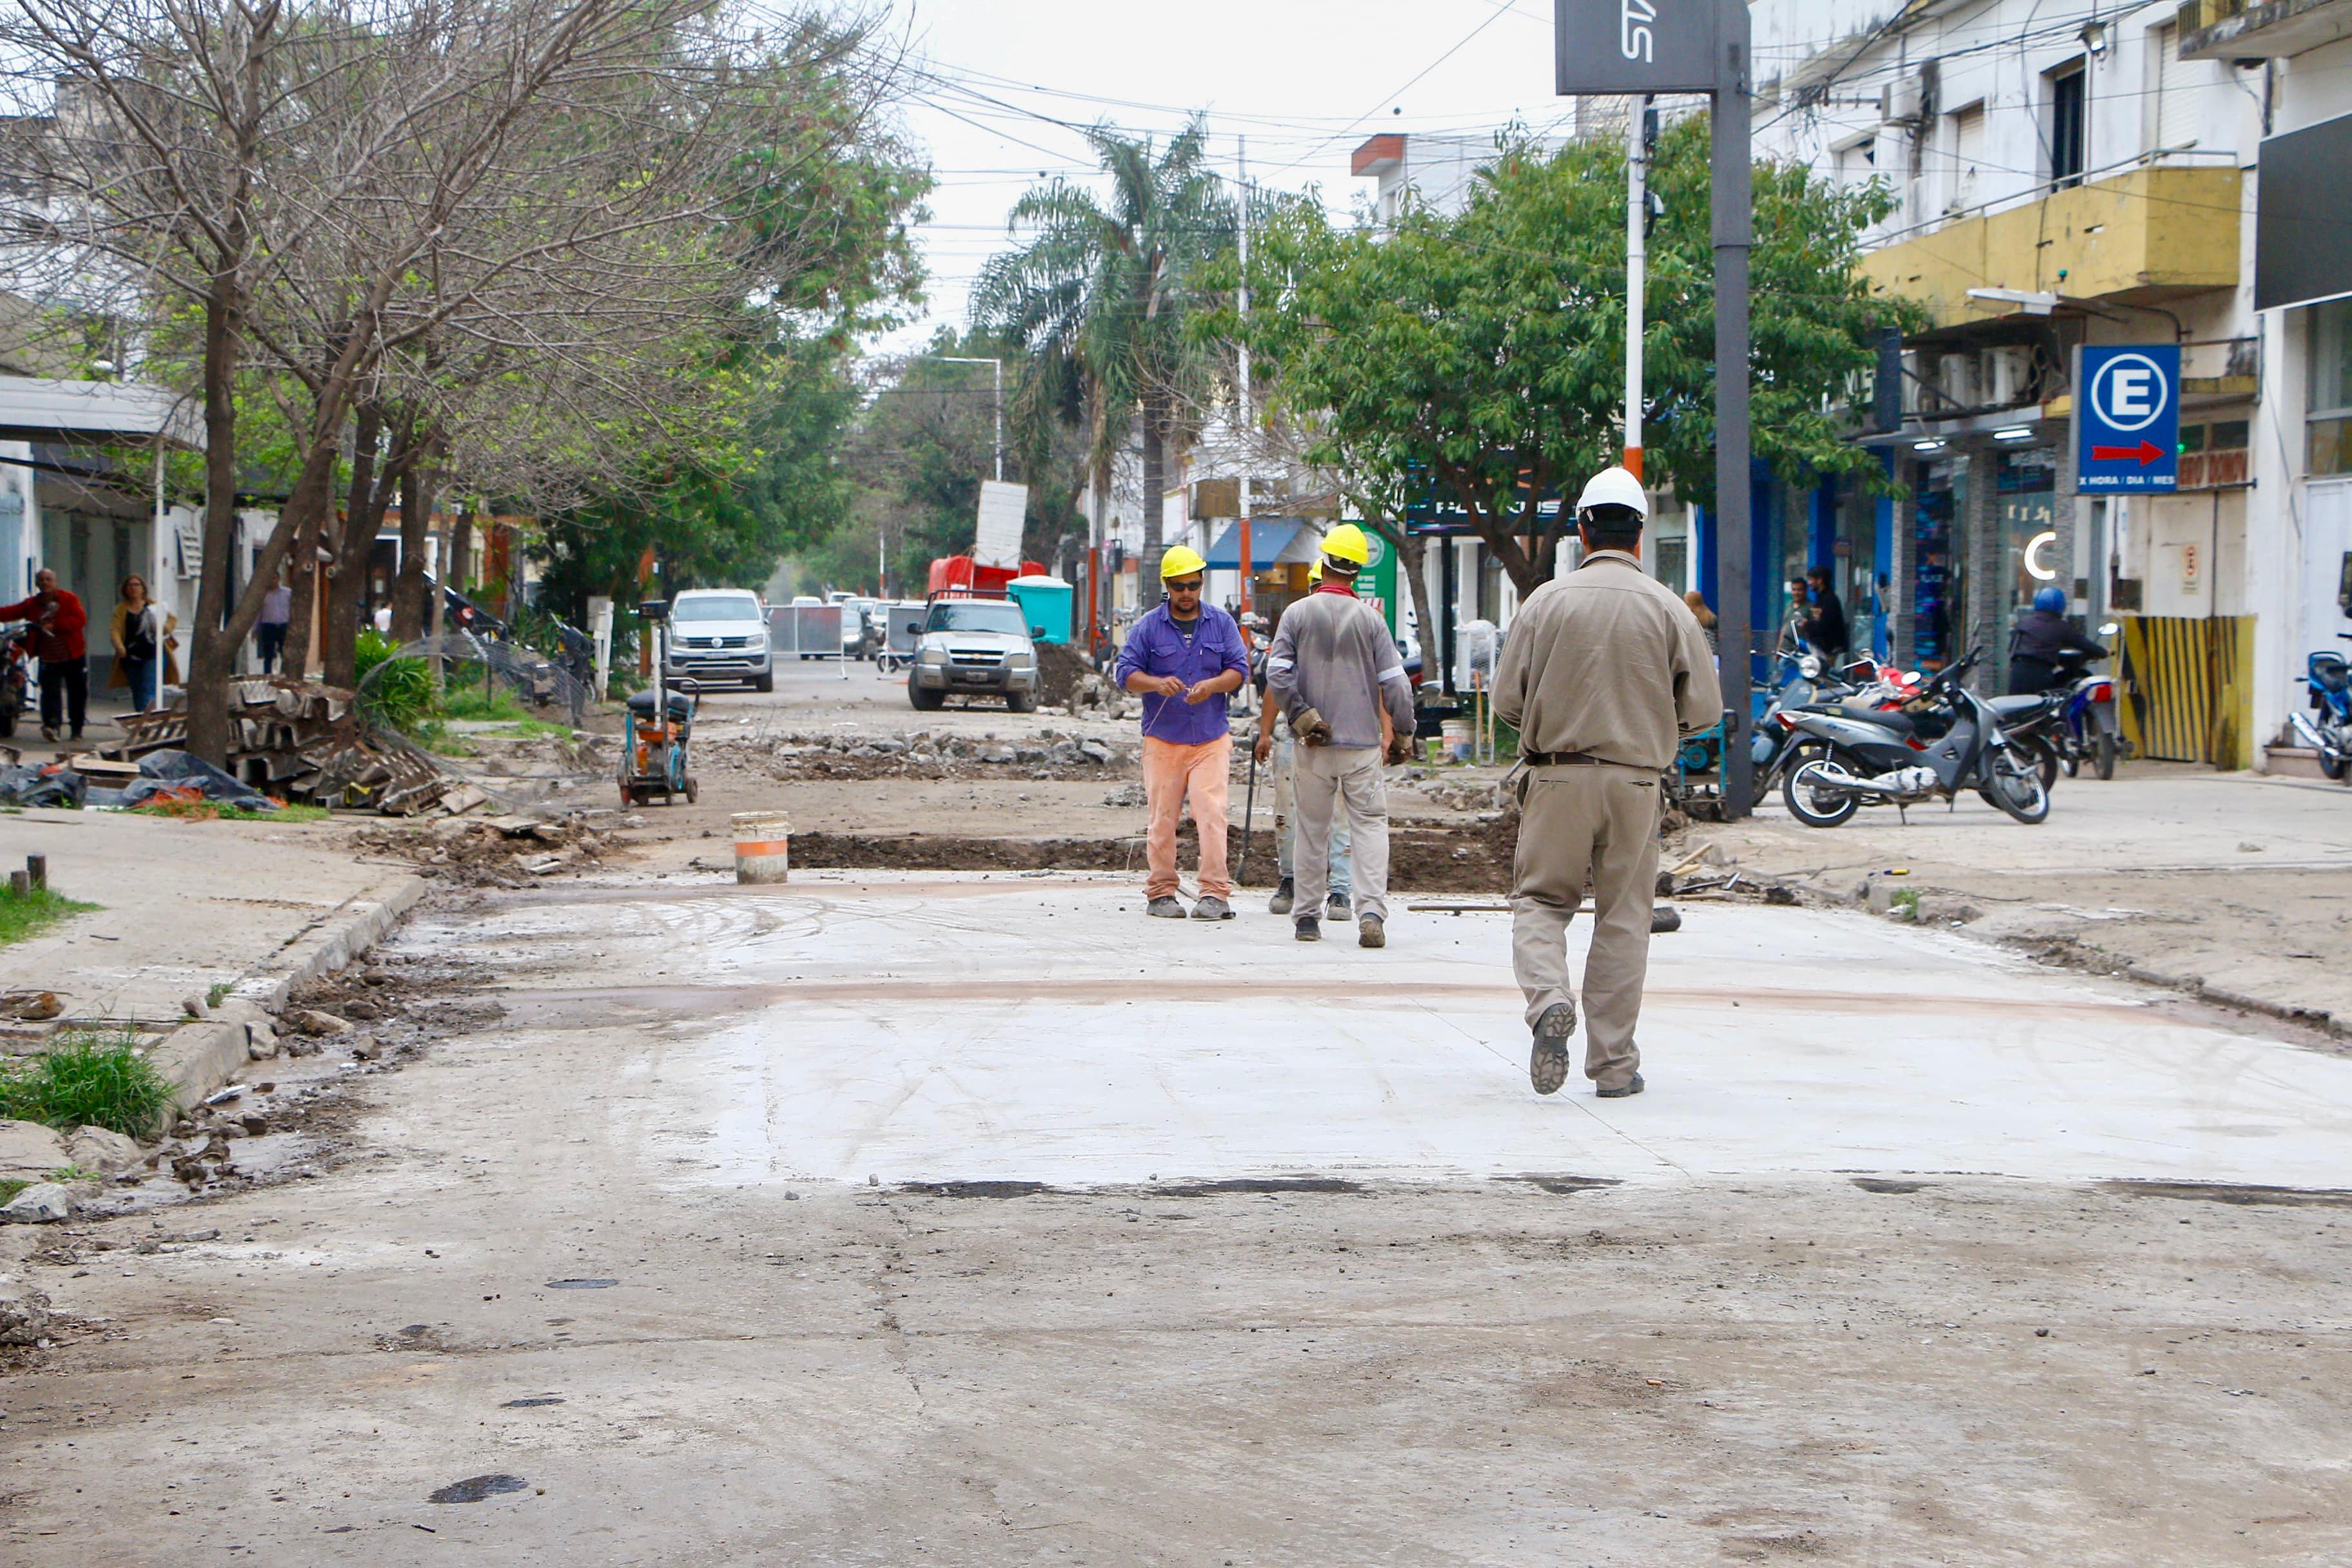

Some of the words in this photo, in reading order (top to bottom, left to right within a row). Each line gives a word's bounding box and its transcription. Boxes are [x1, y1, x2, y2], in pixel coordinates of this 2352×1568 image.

[2112, 369, 2151, 415] E
[2079, 476, 2087, 485] X
[2089, 476, 2119, 484] HORA
[2126, 476, 2145, 484] DIA
[2153, 475, 2175, 484] MES
